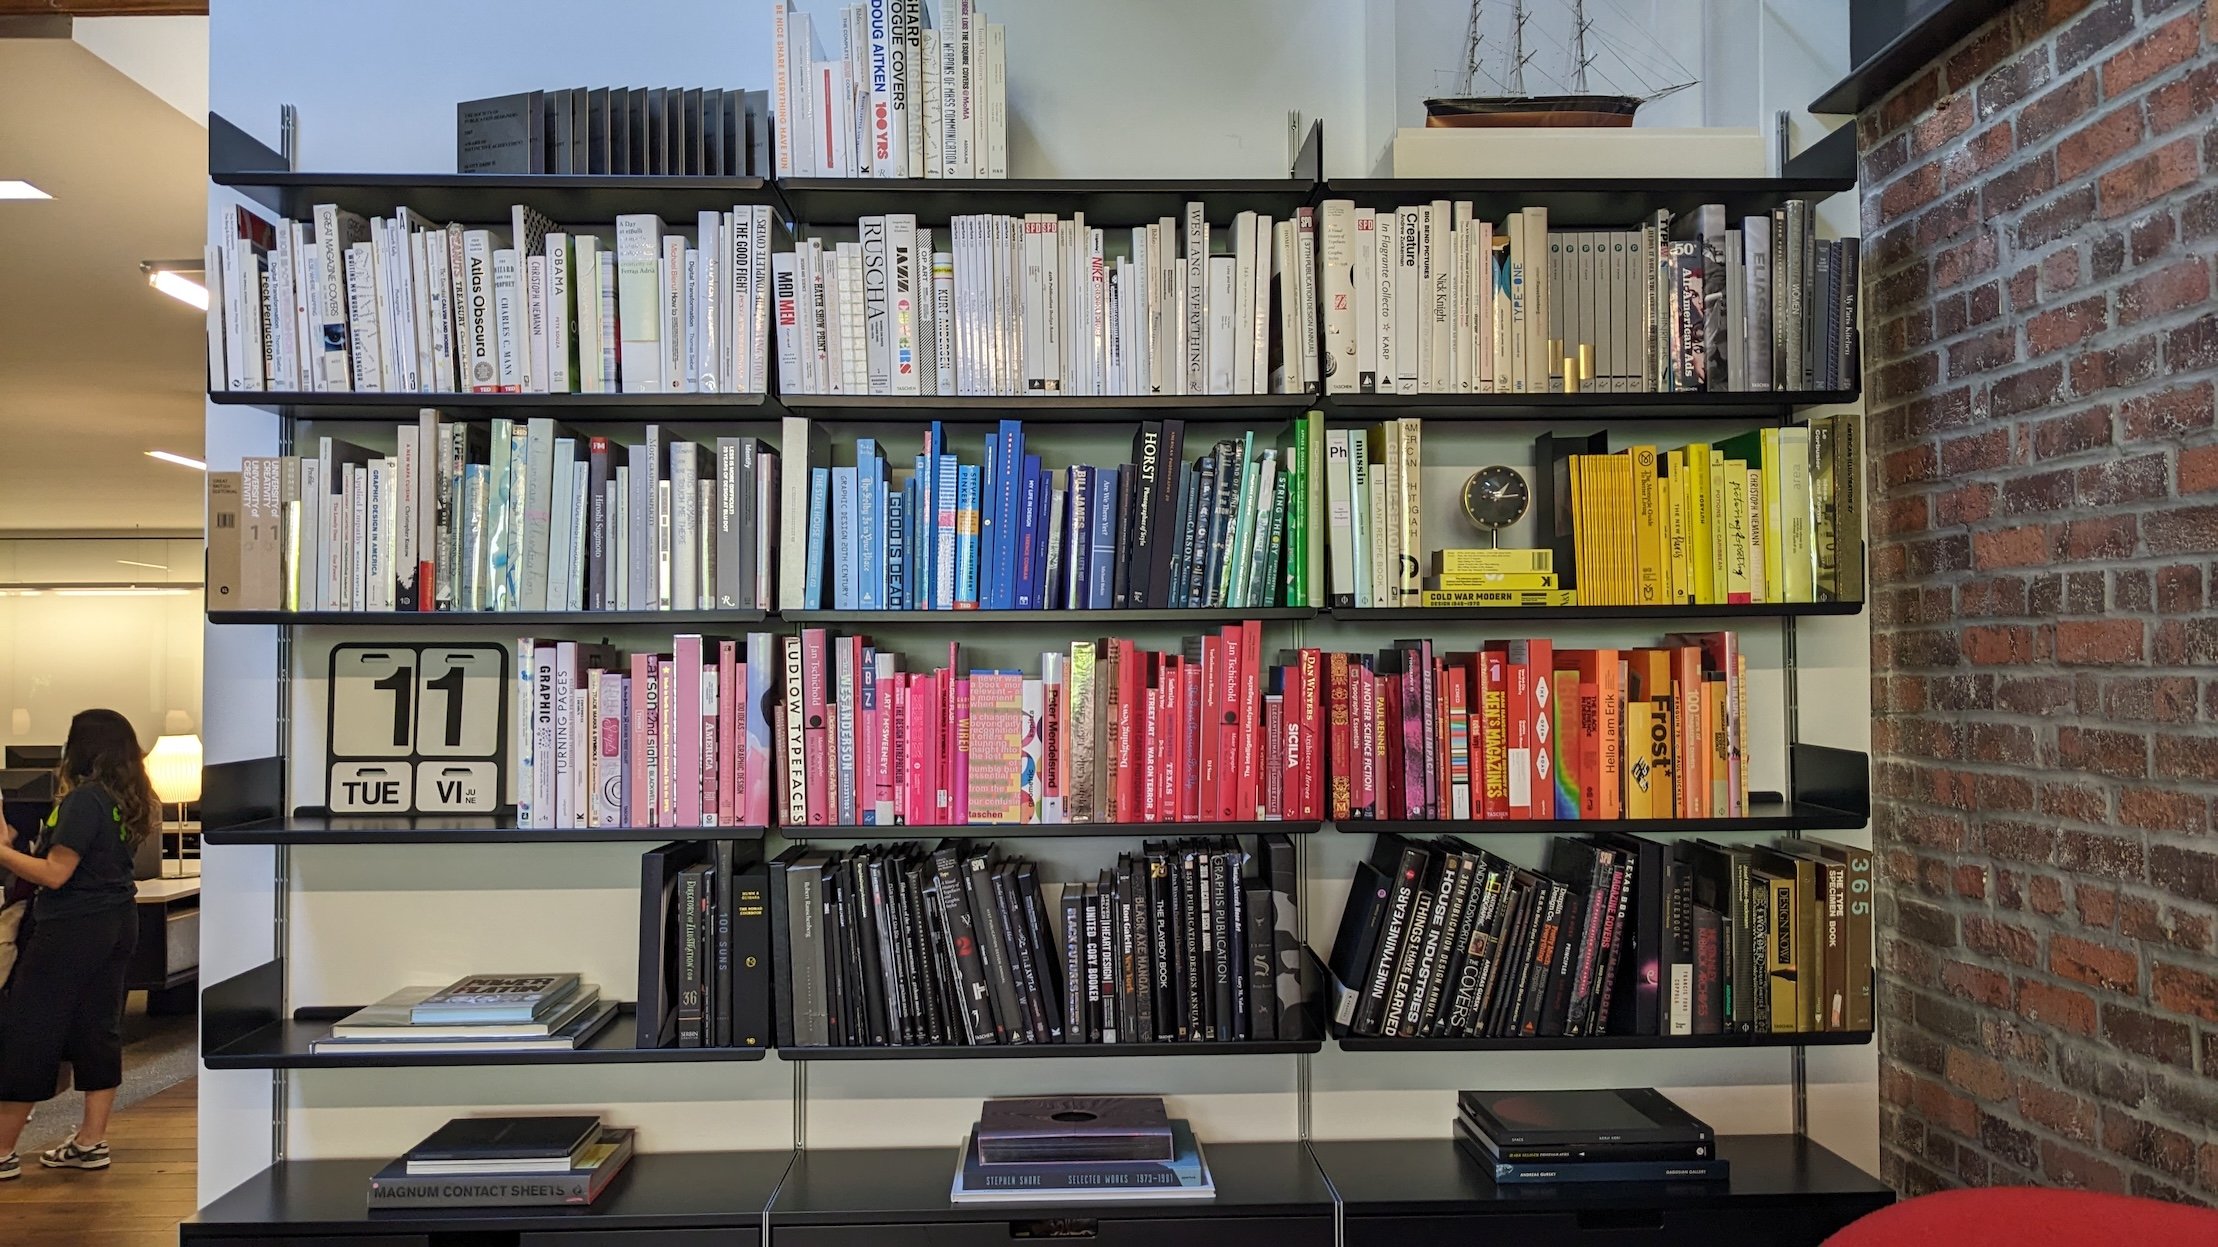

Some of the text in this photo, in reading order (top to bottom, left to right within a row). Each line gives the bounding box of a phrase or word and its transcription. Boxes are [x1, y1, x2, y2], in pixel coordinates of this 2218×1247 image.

[871, 0, 889, 160] DOUG AITKEN 100 YRS
[893, 50, 905, 110] COVERS
[944, 43, 957, 164] WEAPONS OF MASS COMMUNICATION
[1382, 223, 1390, 232] In
[1406, 213, 1417, 266] Creature
[323, 212, 338, 316] GREAT MAGAZINE COVERS
[554, 248, 563, 295] OBAMA
[737, 222, 748, 294] THE GOOD FIGHT
[864, 222, 885, 321] RUSCHA
[1092, 257, 1102, 282] NIKE
[1380, 235, 1390, 278] Flagrante
[350, 284, 356, 292] MY
[350, 295, 358, 322] WRONGS
[471, 257, 486, 357] Atlas Obscura
[531, 262, 542, 335] CHRISTOPH NIEMANN
[778, 272, 795, 325] MAD MEN
[1191, 210, 1200, 372] WES LANG EVERYTHING
[1382, 281, 1391, 317] Collecto
[1434, 273, 1446, 322] Nick Knight
[938, 290, 950, 369] KURT ANDERSEN
[1683, 268, 1694, 376] All-American Ads
[1142, 432, 1157, 482] HORST
[1330, 447, 1347, 457] Ph
[1356, 440, 1365, 485] massin
[1028, 480, 1034, 488] MY
[1750, 474, 1759, 545] CHRISTOPH NIEMANN
[372, 533, 378, 541] IN
[594, 495, 603, 557] Hiroshi Sugimoto
[1184, 522, 1194, 561] CARSON
[540, 666, 550, 723] GRAPHIC
[809, 644, 820, 706] Jan Tschichold
[1227, 641, 1237, 702] Jan Tschichold
[1307, 657, 1315, 675] DAN
[558, 671, 567, 774] TURNING PAGES
[839, 675, 852, 770] WES ANDERSON
[1687, 689, 1699, 712] 100
[705, 722, 714, 770] AMERICA
[788, 642, 804, 822] LUDLOW TYPEFACES
[959, 718, 969, 752] WIRED
[1048, 690, 1058, 788] Peter Mendelsund
[1288, 724, 1298, 768] SICILIA
[1363, 682, 1372, 790] ANOTHER SCIENCE FICTION
[1377, 721, 1385, 756] RENNER
[1485, 691, 1501, 798] MEN'S MAGAZINES
[342, 781, 462, 804] TUE VI
[1618, 859, 1634, 918] TEXAS BBQ
[1673, 889, 1681, 938] NOTEBOOK
[719, 913, 728, 970] 100 SUNS
[1214, 856, 1227, 984] GRAPHIS PUBLICATION
[1407, 869, 1455, 1023] HOUSE INDUSTRIES
[1778, 889, 1789, 963] DESIGN NOW!
[1086, 907, 1098, 1002] UNITED CORY BOOKER
[1451, 965, 1478, 1027] COVERS
[374, 1185, 565, 1199] MAGNUM CONTACT SHEETS
[987, 1175, 1041, 1186] STEPHEN SHORE
